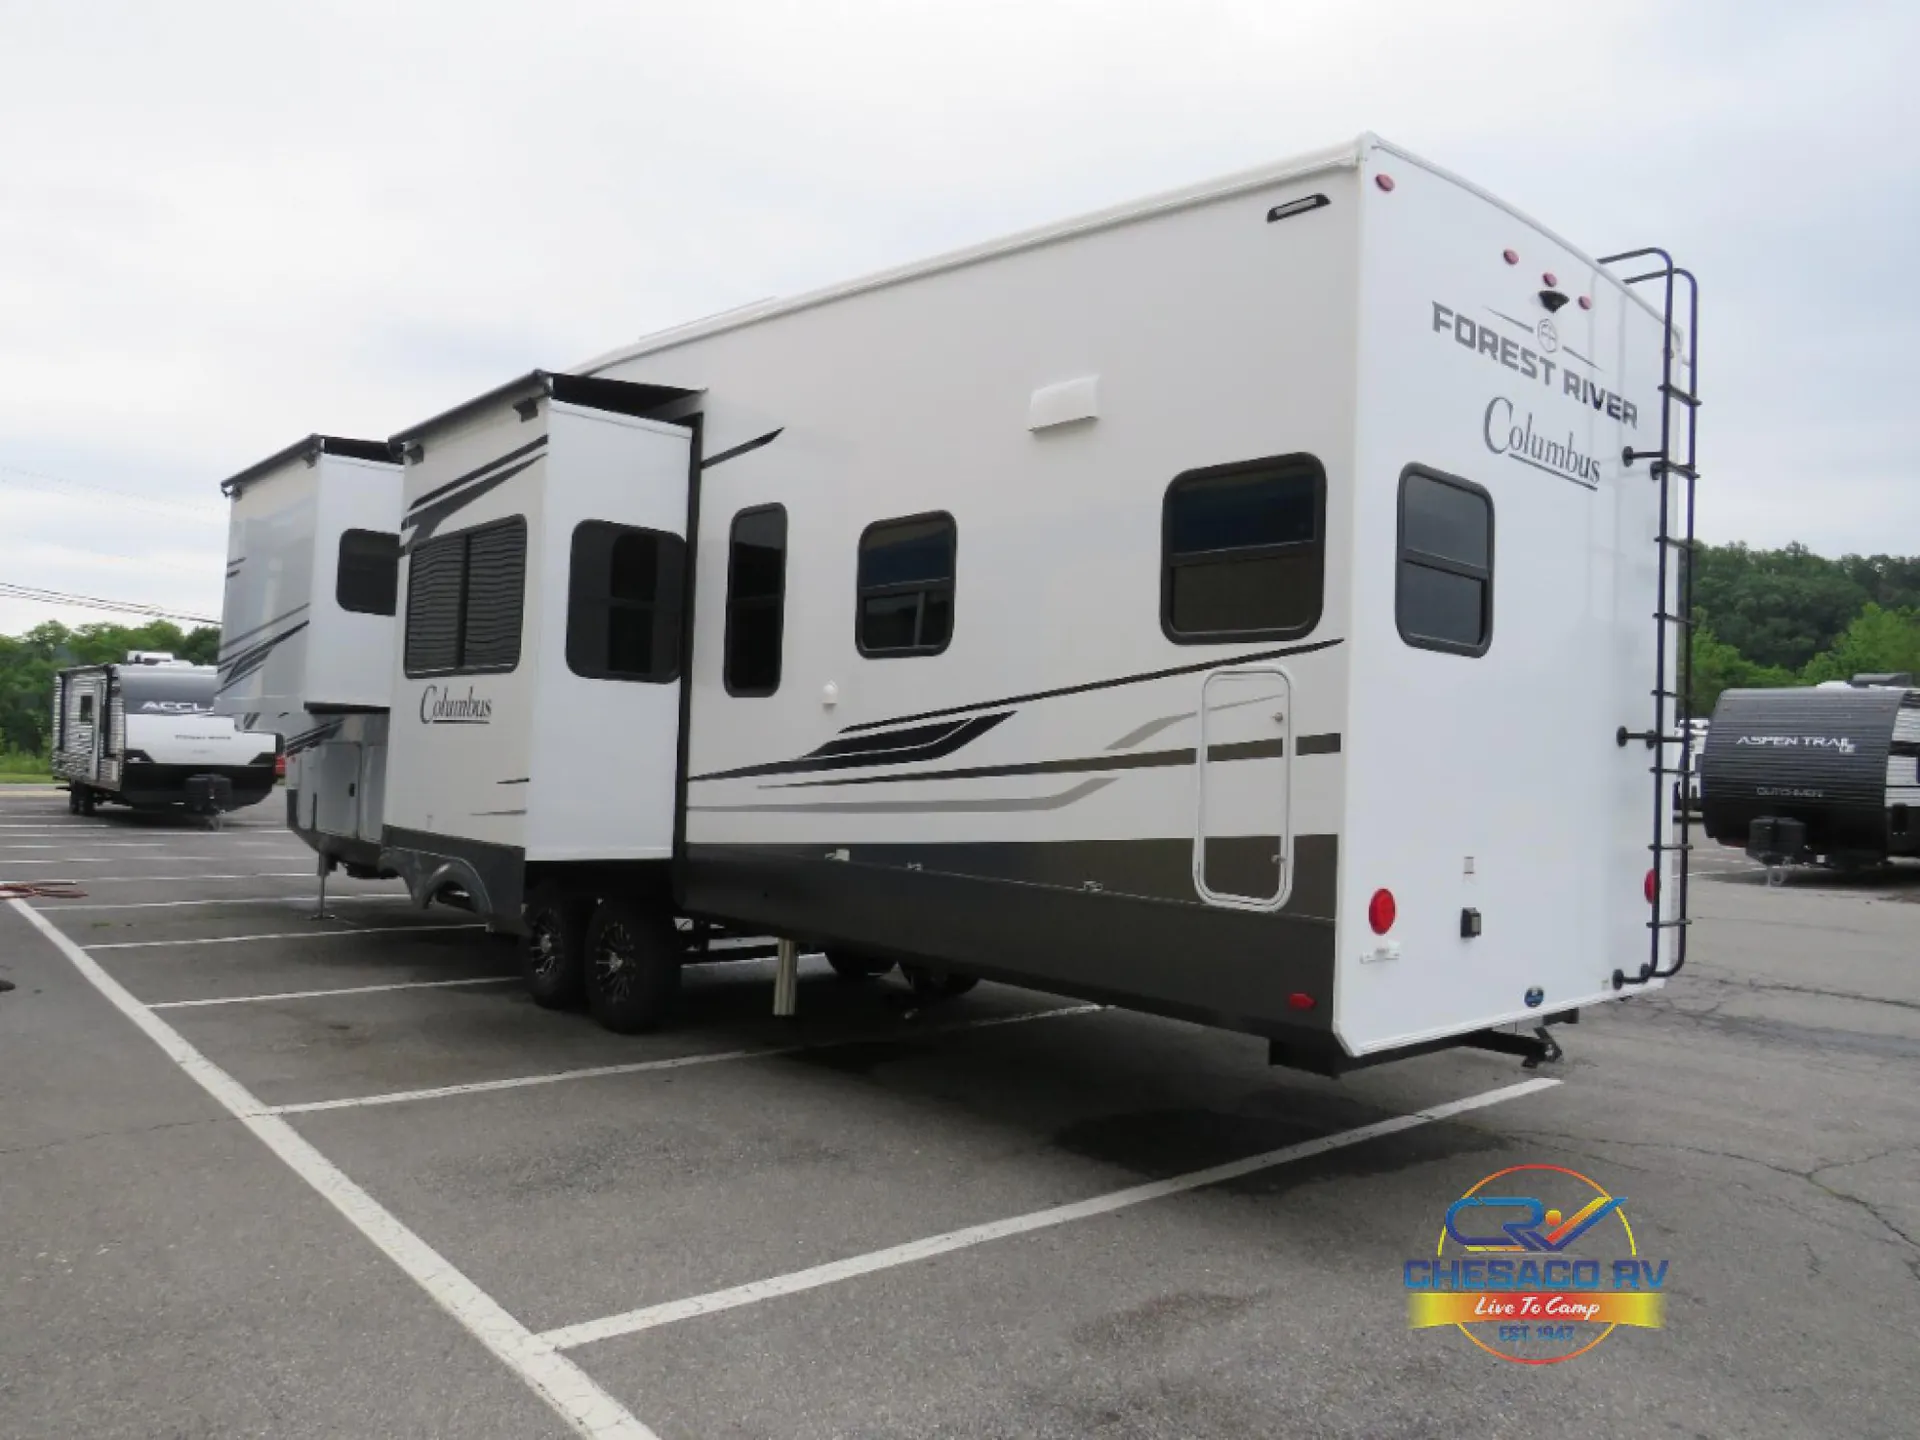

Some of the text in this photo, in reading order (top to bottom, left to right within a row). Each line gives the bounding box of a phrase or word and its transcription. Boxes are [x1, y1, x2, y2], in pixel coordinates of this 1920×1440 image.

[1432, 300, 1556, 386] FOREST
[1563, 368, 1638, 429] RIVER
[1483, 396, 1601, 484] Columbus
[420, 683, 492, 724] Columbus
[1736, 735, 1850, 747] ASPEN TRAIL
